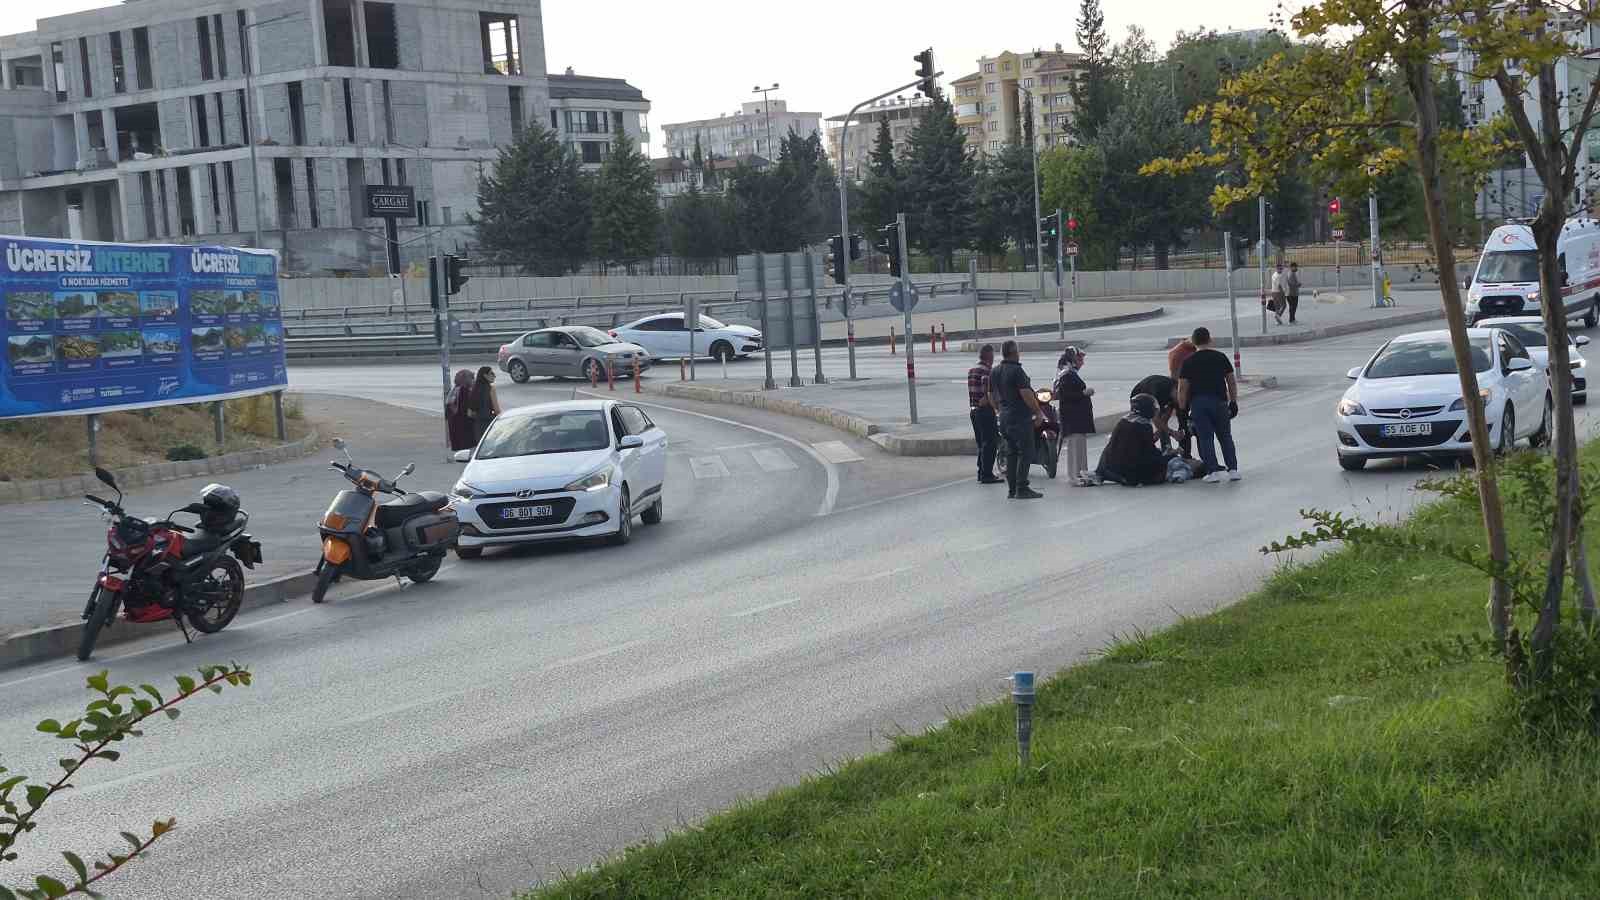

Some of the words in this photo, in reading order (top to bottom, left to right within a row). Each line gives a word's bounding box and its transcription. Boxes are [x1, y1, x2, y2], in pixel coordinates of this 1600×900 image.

[7, 243, 92, 272] ÜCRETSİZ
[192, 247, 240, 273] ÜCRETSİZ
[68, 278, 99, 286] NOKTADA
[1400, 424, 1417, 434] ADE
